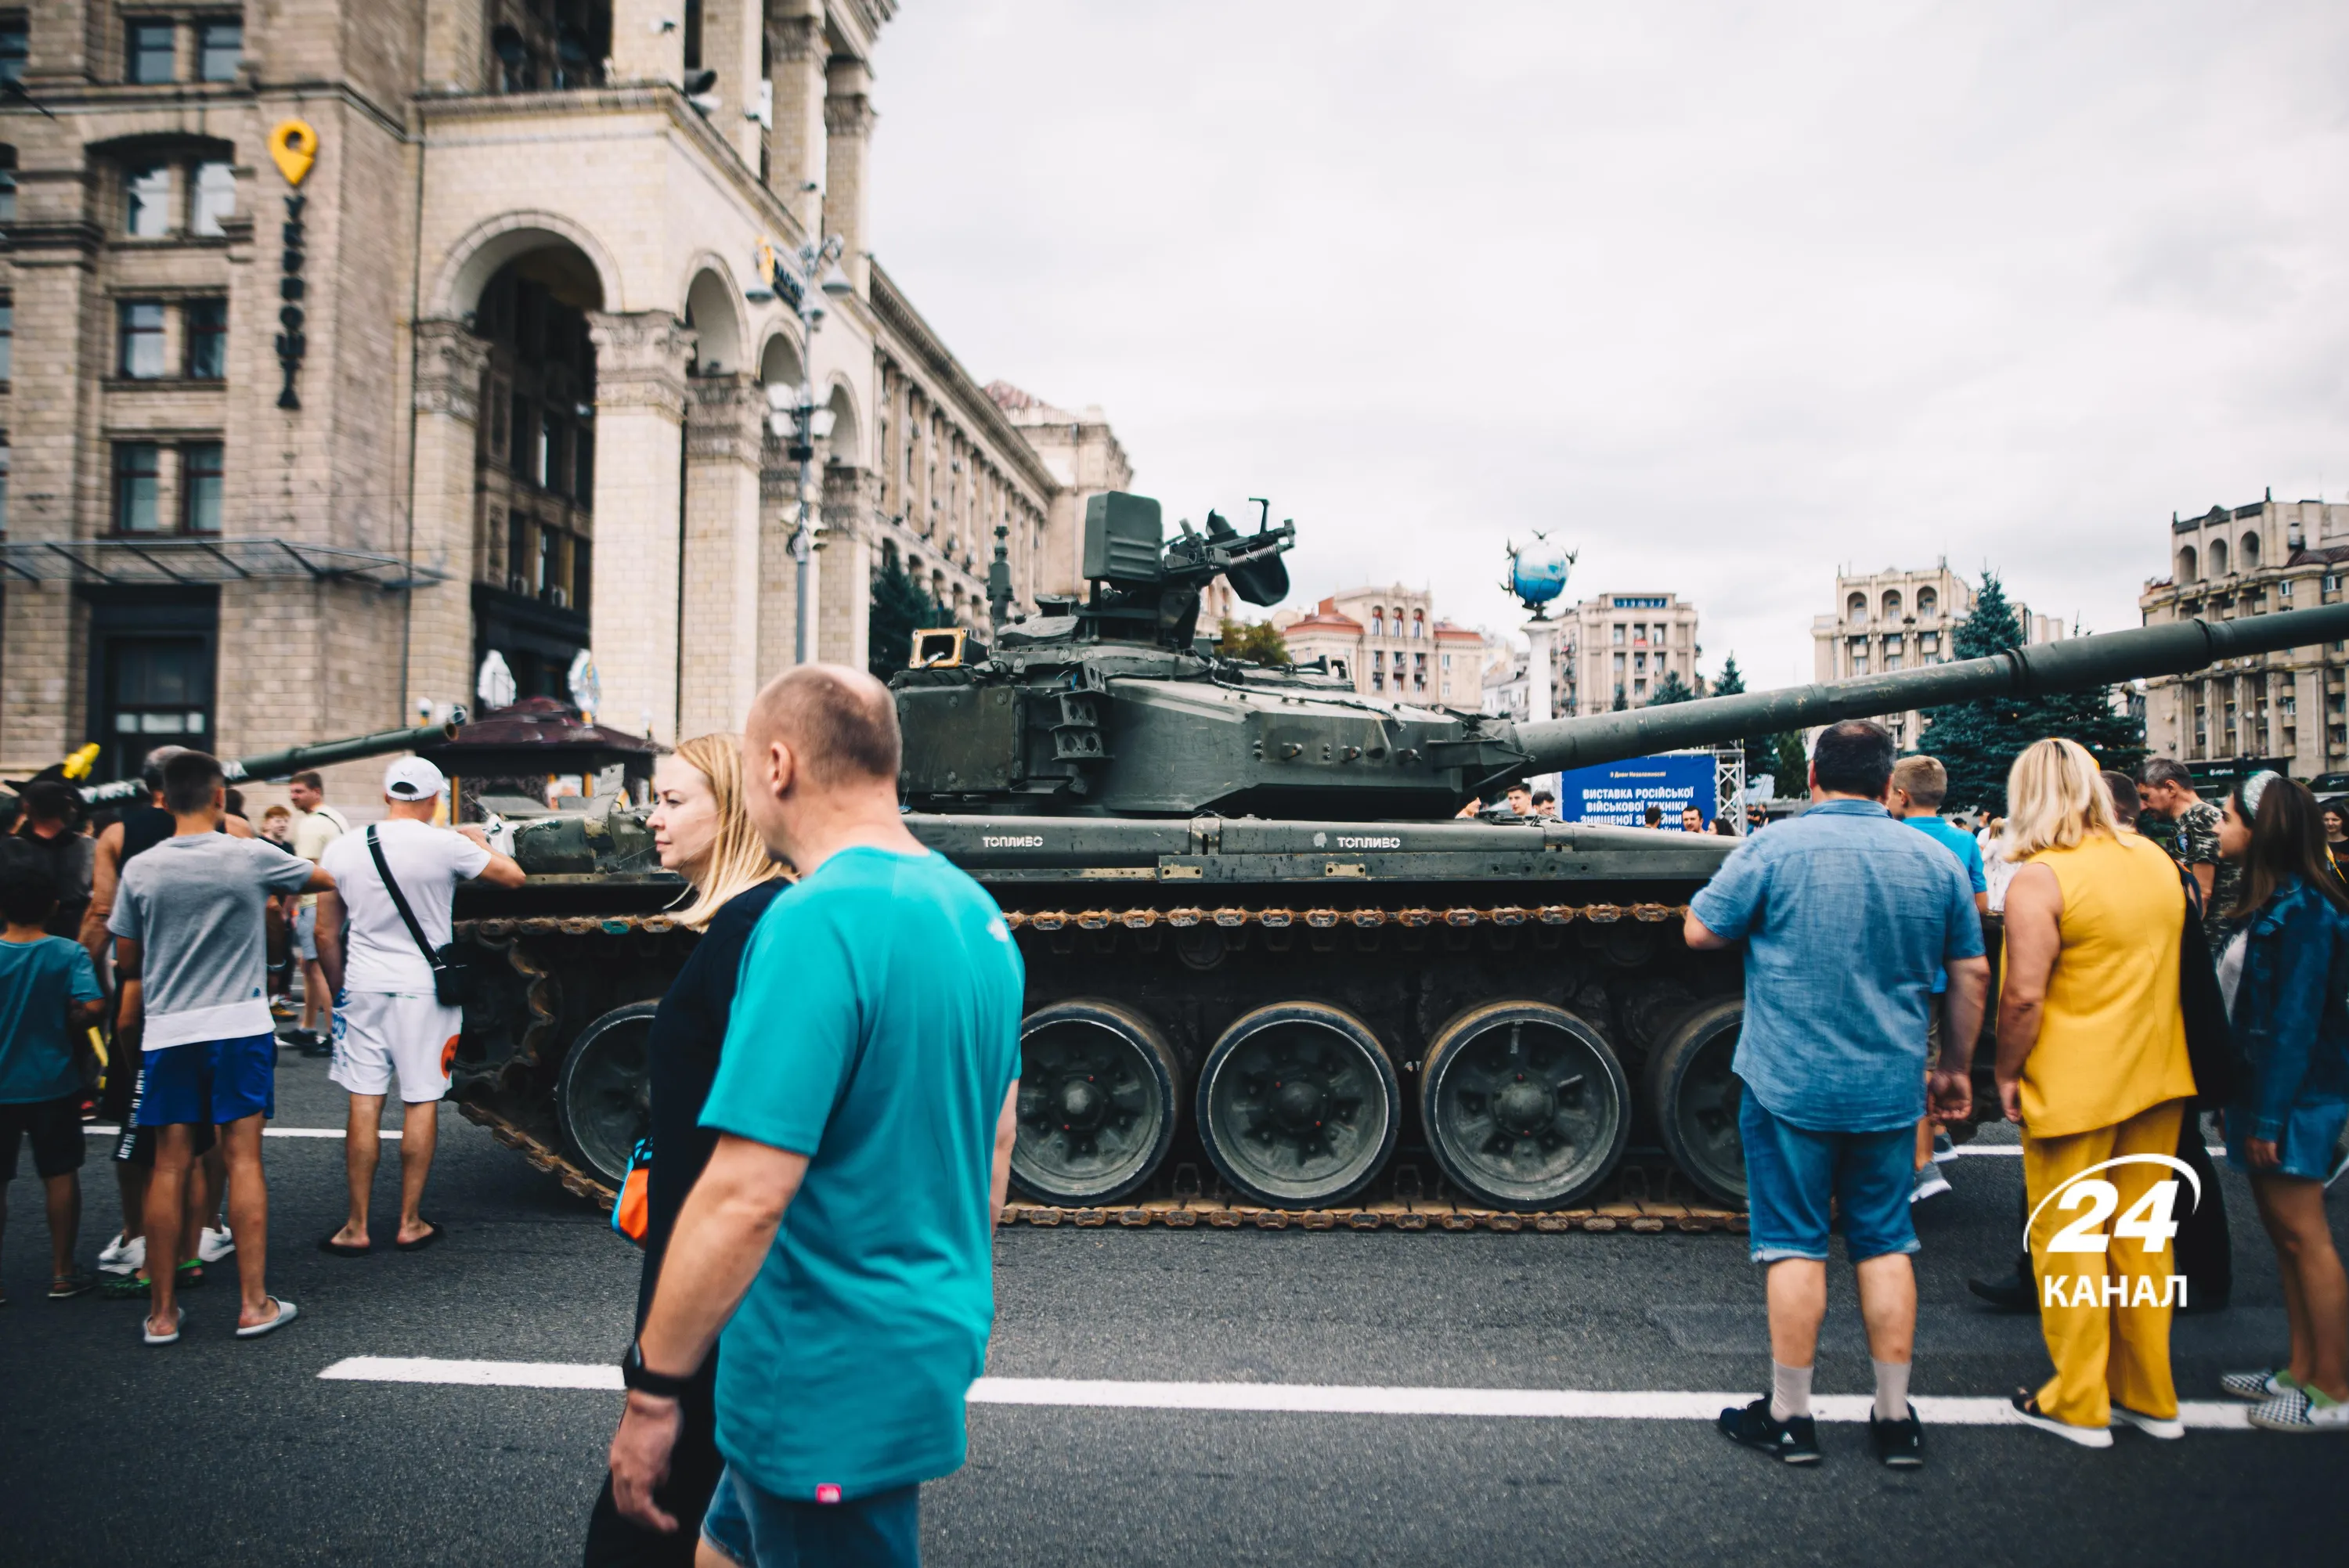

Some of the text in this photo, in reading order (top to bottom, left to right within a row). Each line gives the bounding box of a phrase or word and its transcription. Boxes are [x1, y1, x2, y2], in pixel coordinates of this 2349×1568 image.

[1582, 786, 1694, 799] ВИСТАВКА РОСІЙСЬКОЇ
[1586, 800, 1644, 813] ВІЙСЬКОВОЇ
[982, 836, 1044, 848] ТОПЛИВО
[1337, 837, 1401, 849] ТОПЛИВО
[117, 1134, 136, 1159] READY
